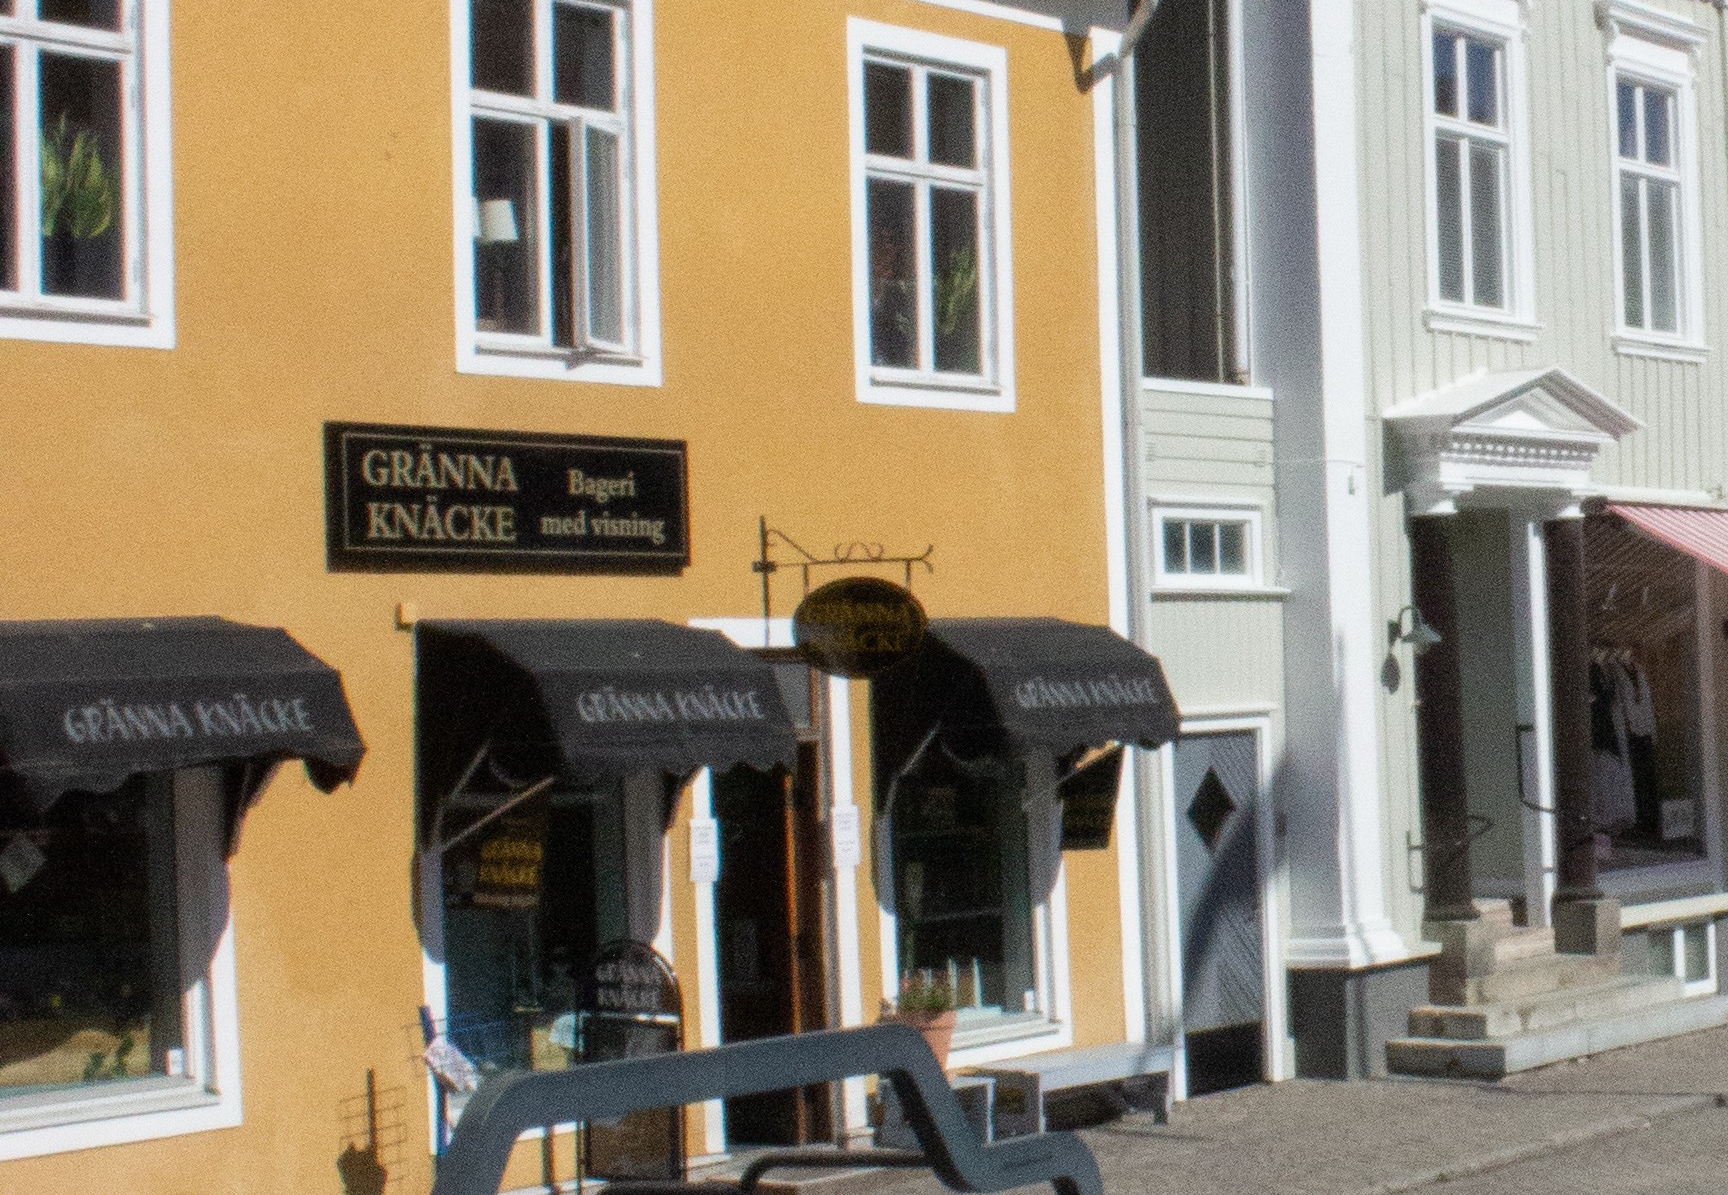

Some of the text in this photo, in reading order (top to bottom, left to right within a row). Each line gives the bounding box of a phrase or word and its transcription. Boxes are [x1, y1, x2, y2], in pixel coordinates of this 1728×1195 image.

[362, 443, 518, 491] GRÄNNA
[567, 469, 636, 503] Bageri
[367, 495, 518, 543] KNÄCKE
[540, 510, 665, 545] med visning
[62, 692, 314, 744] GRÄNNA KNÄCKE
[577, 683, 766, 723] GRÄNNA KNÄCKE
